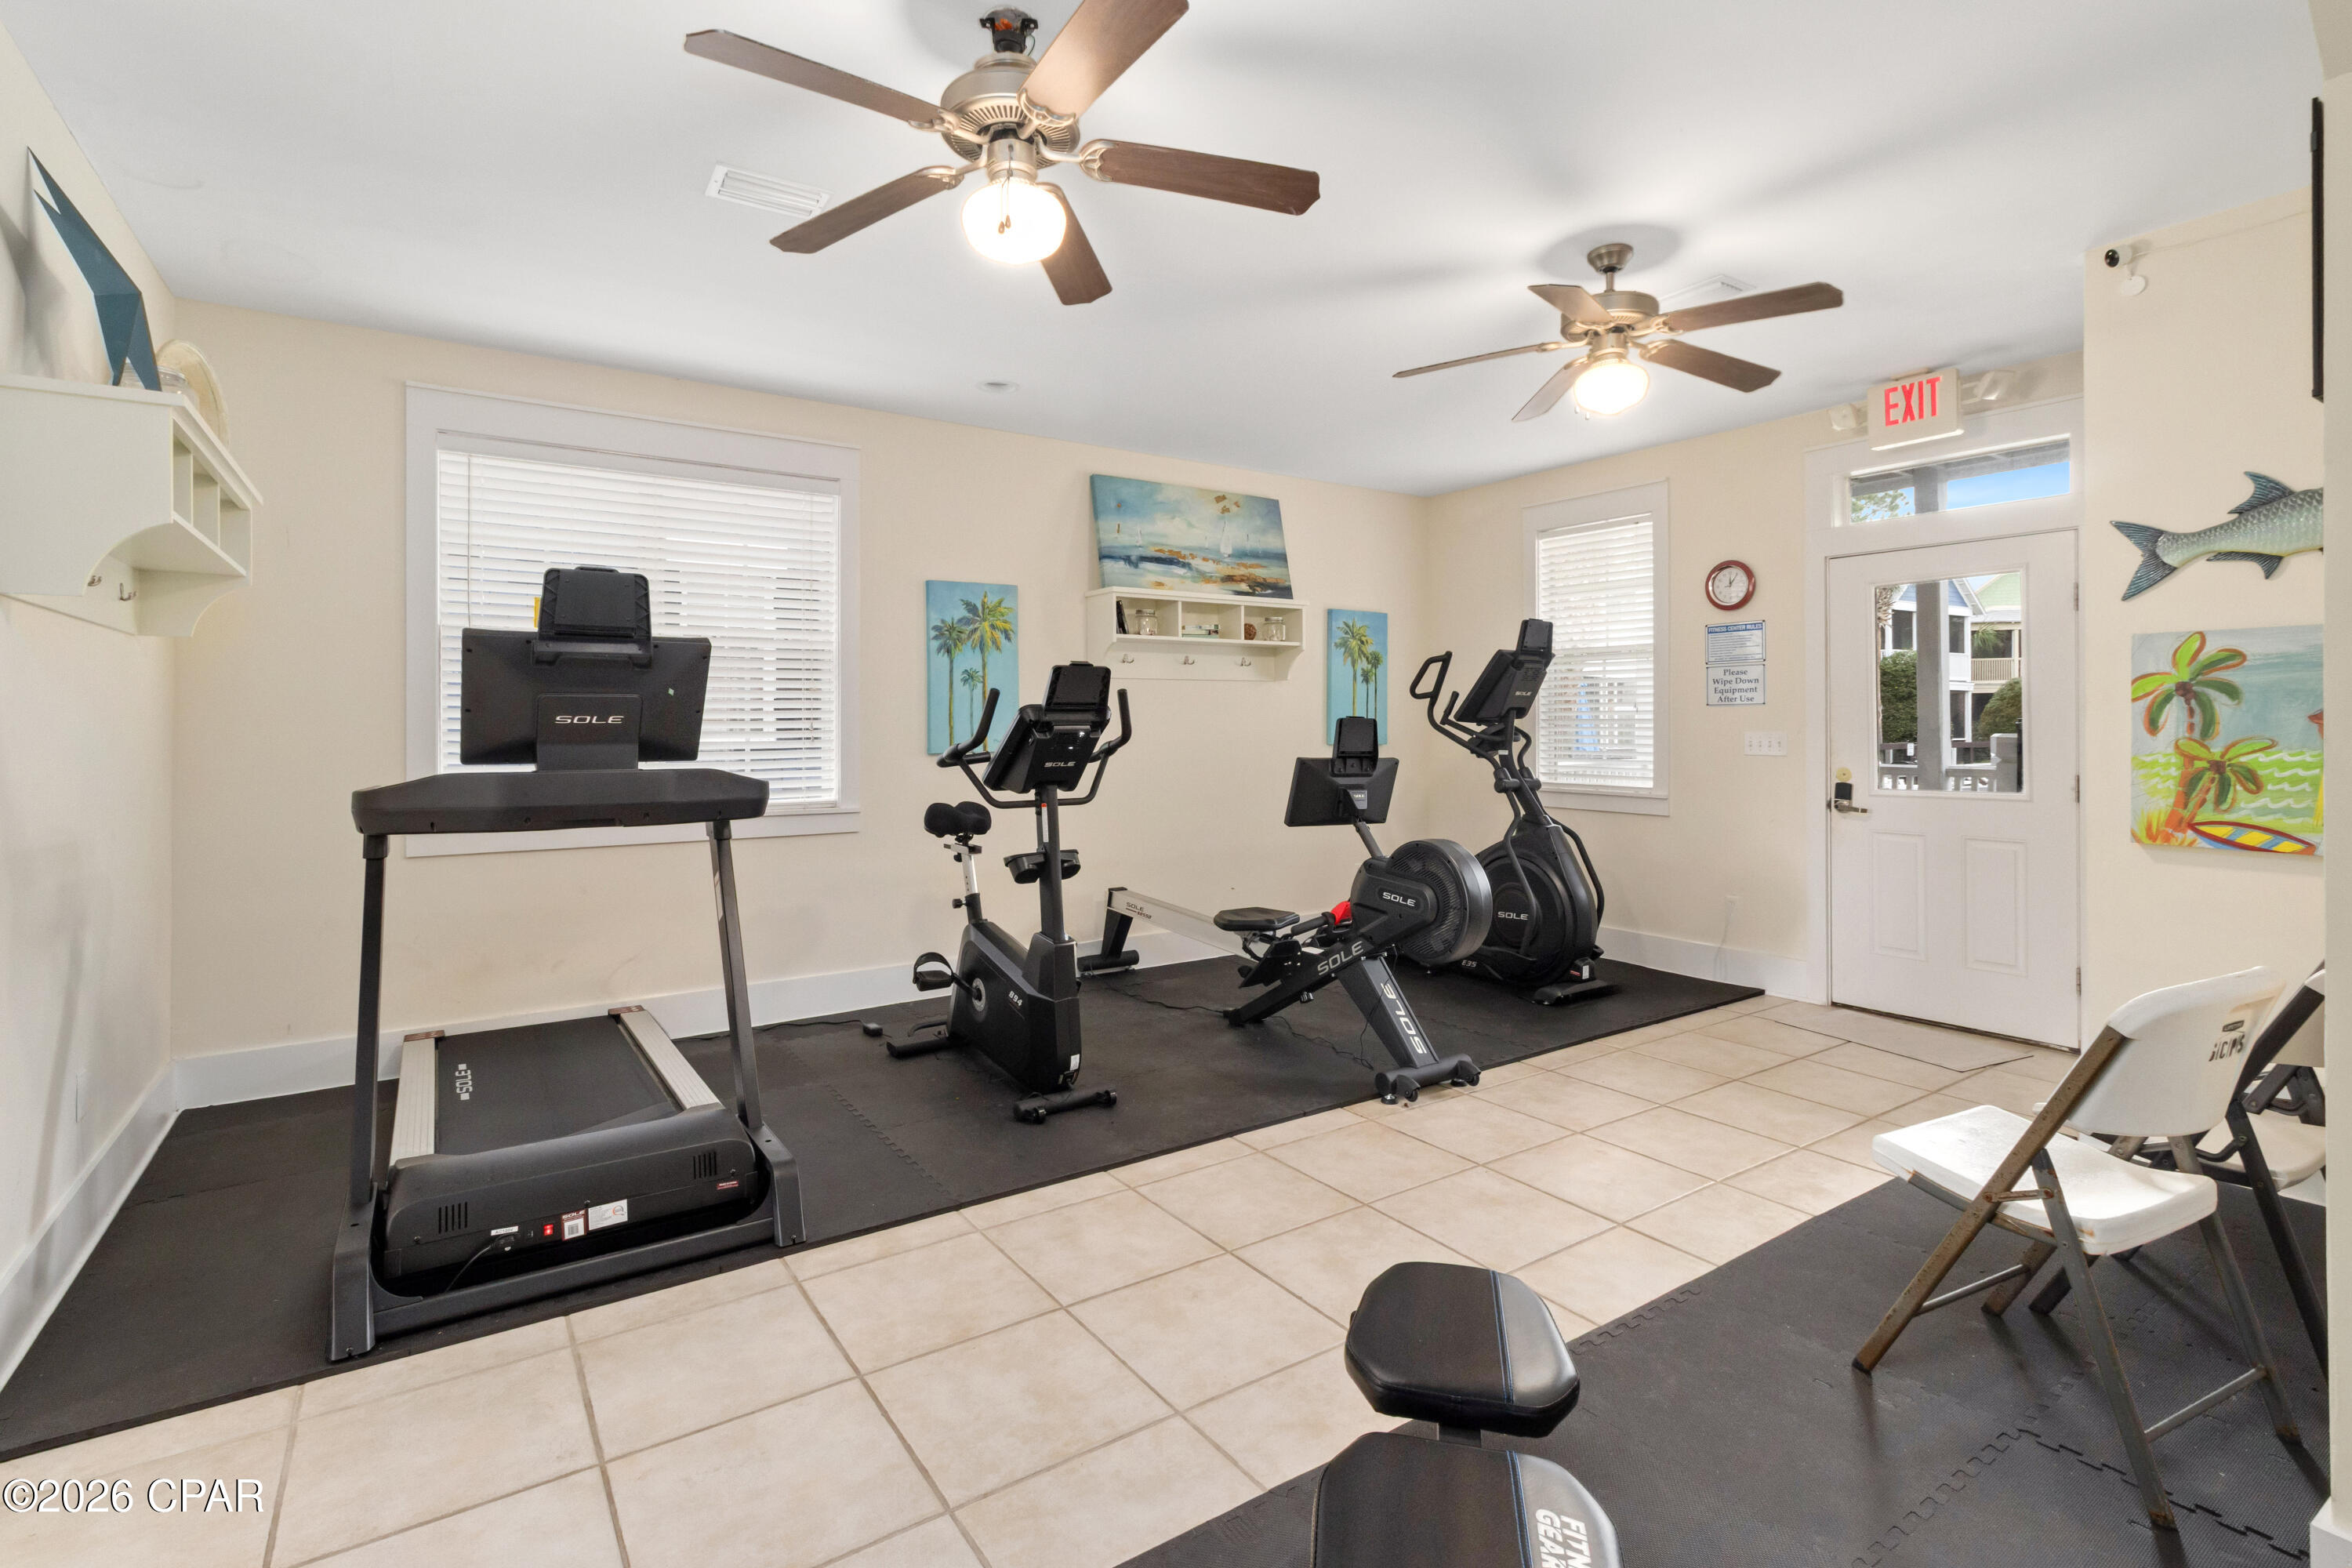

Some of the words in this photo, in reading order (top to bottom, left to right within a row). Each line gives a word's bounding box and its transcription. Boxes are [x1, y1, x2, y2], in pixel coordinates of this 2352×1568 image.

[1884, 376, 1941, 426] EXIT
[1714, 687, 1758, 695] Equipment
[555, 715, 625, 724] SOLE
[1382, 891, 1417, 907] SOLE
[1126, 902, 1145, 913] SOLE
[1497, 911, 1529, 920] SOLE
[1317, 941, 1364, 976] SOLE
[1381, 982, 1427, 1054] SOLE
[455, 1069, 473, 1094] SOLE
